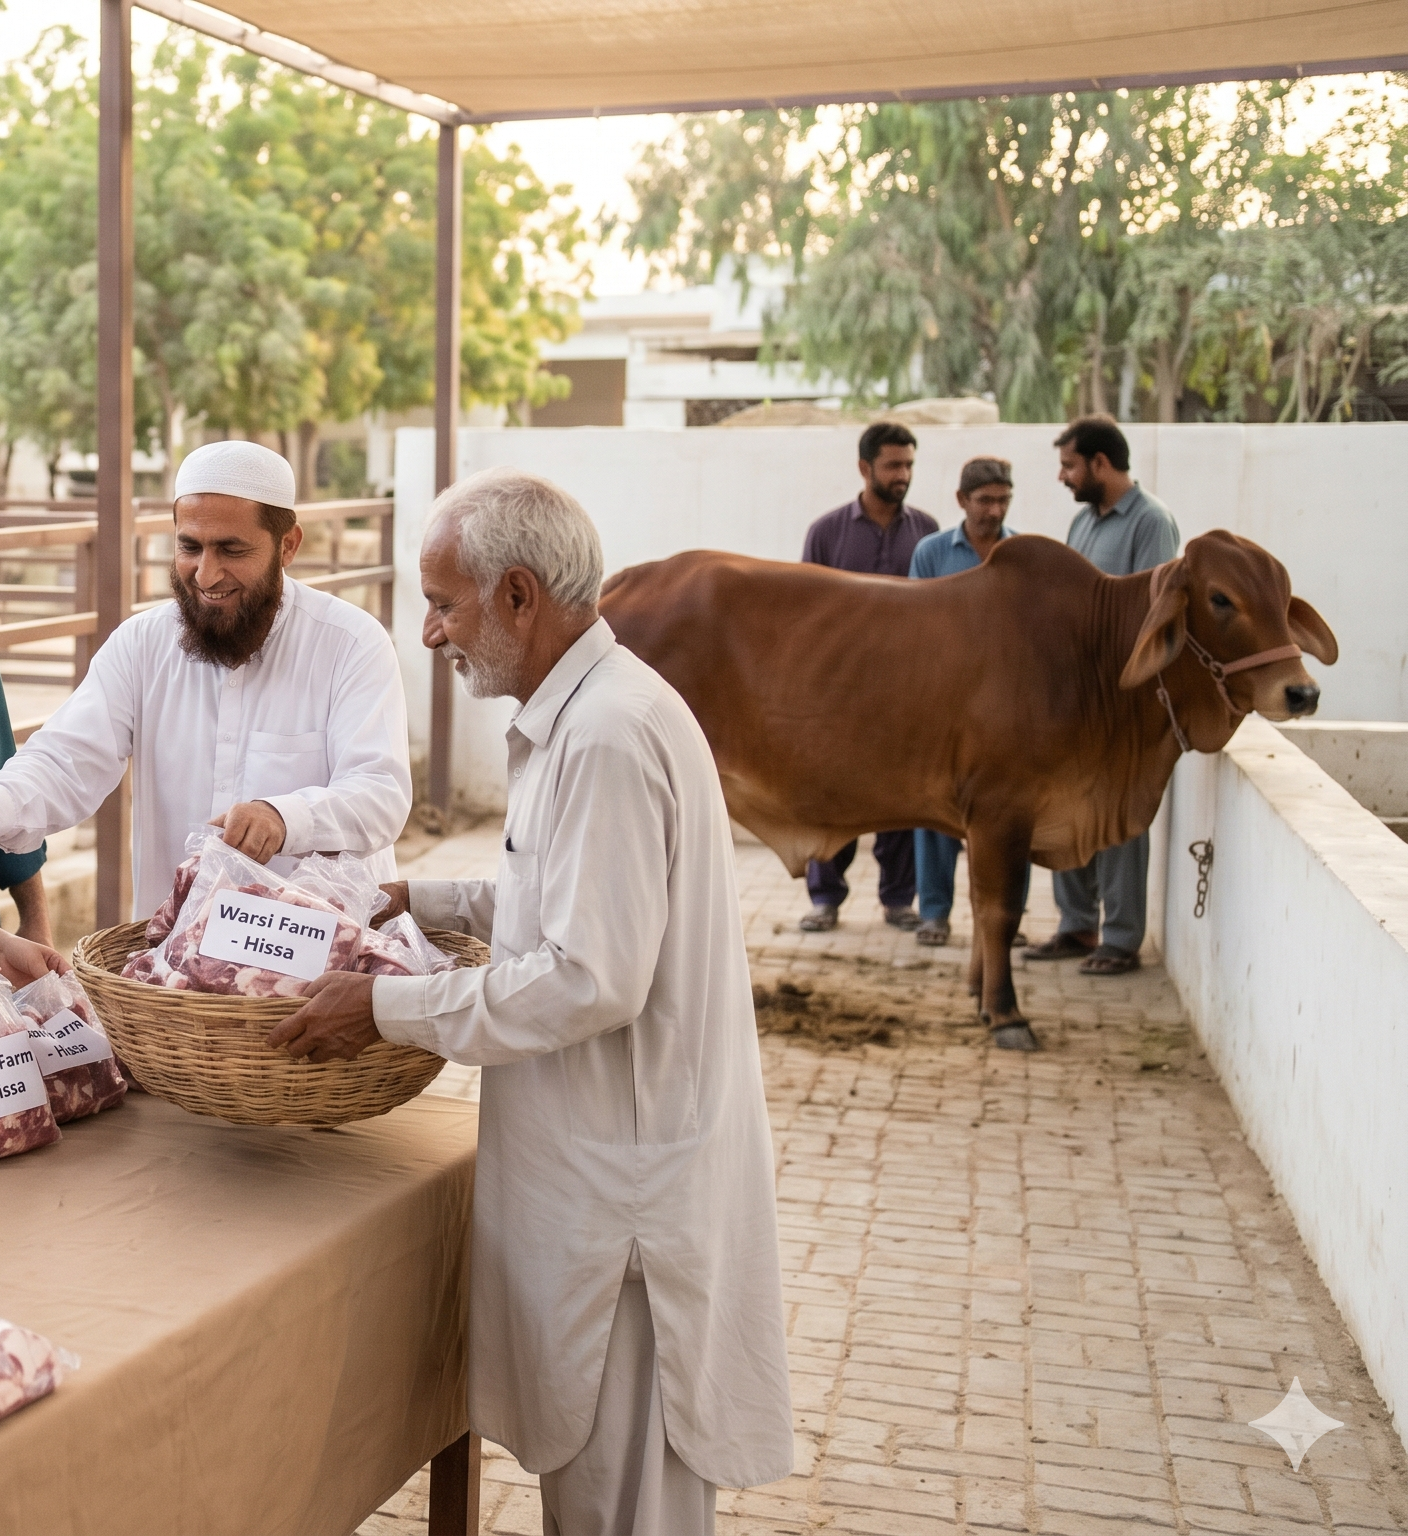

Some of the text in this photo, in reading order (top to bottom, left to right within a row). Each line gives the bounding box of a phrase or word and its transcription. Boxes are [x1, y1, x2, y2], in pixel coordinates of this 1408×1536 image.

[219, 904, 326, 941] Warsi Farm
[243, 934, 295, 960] Hissa
